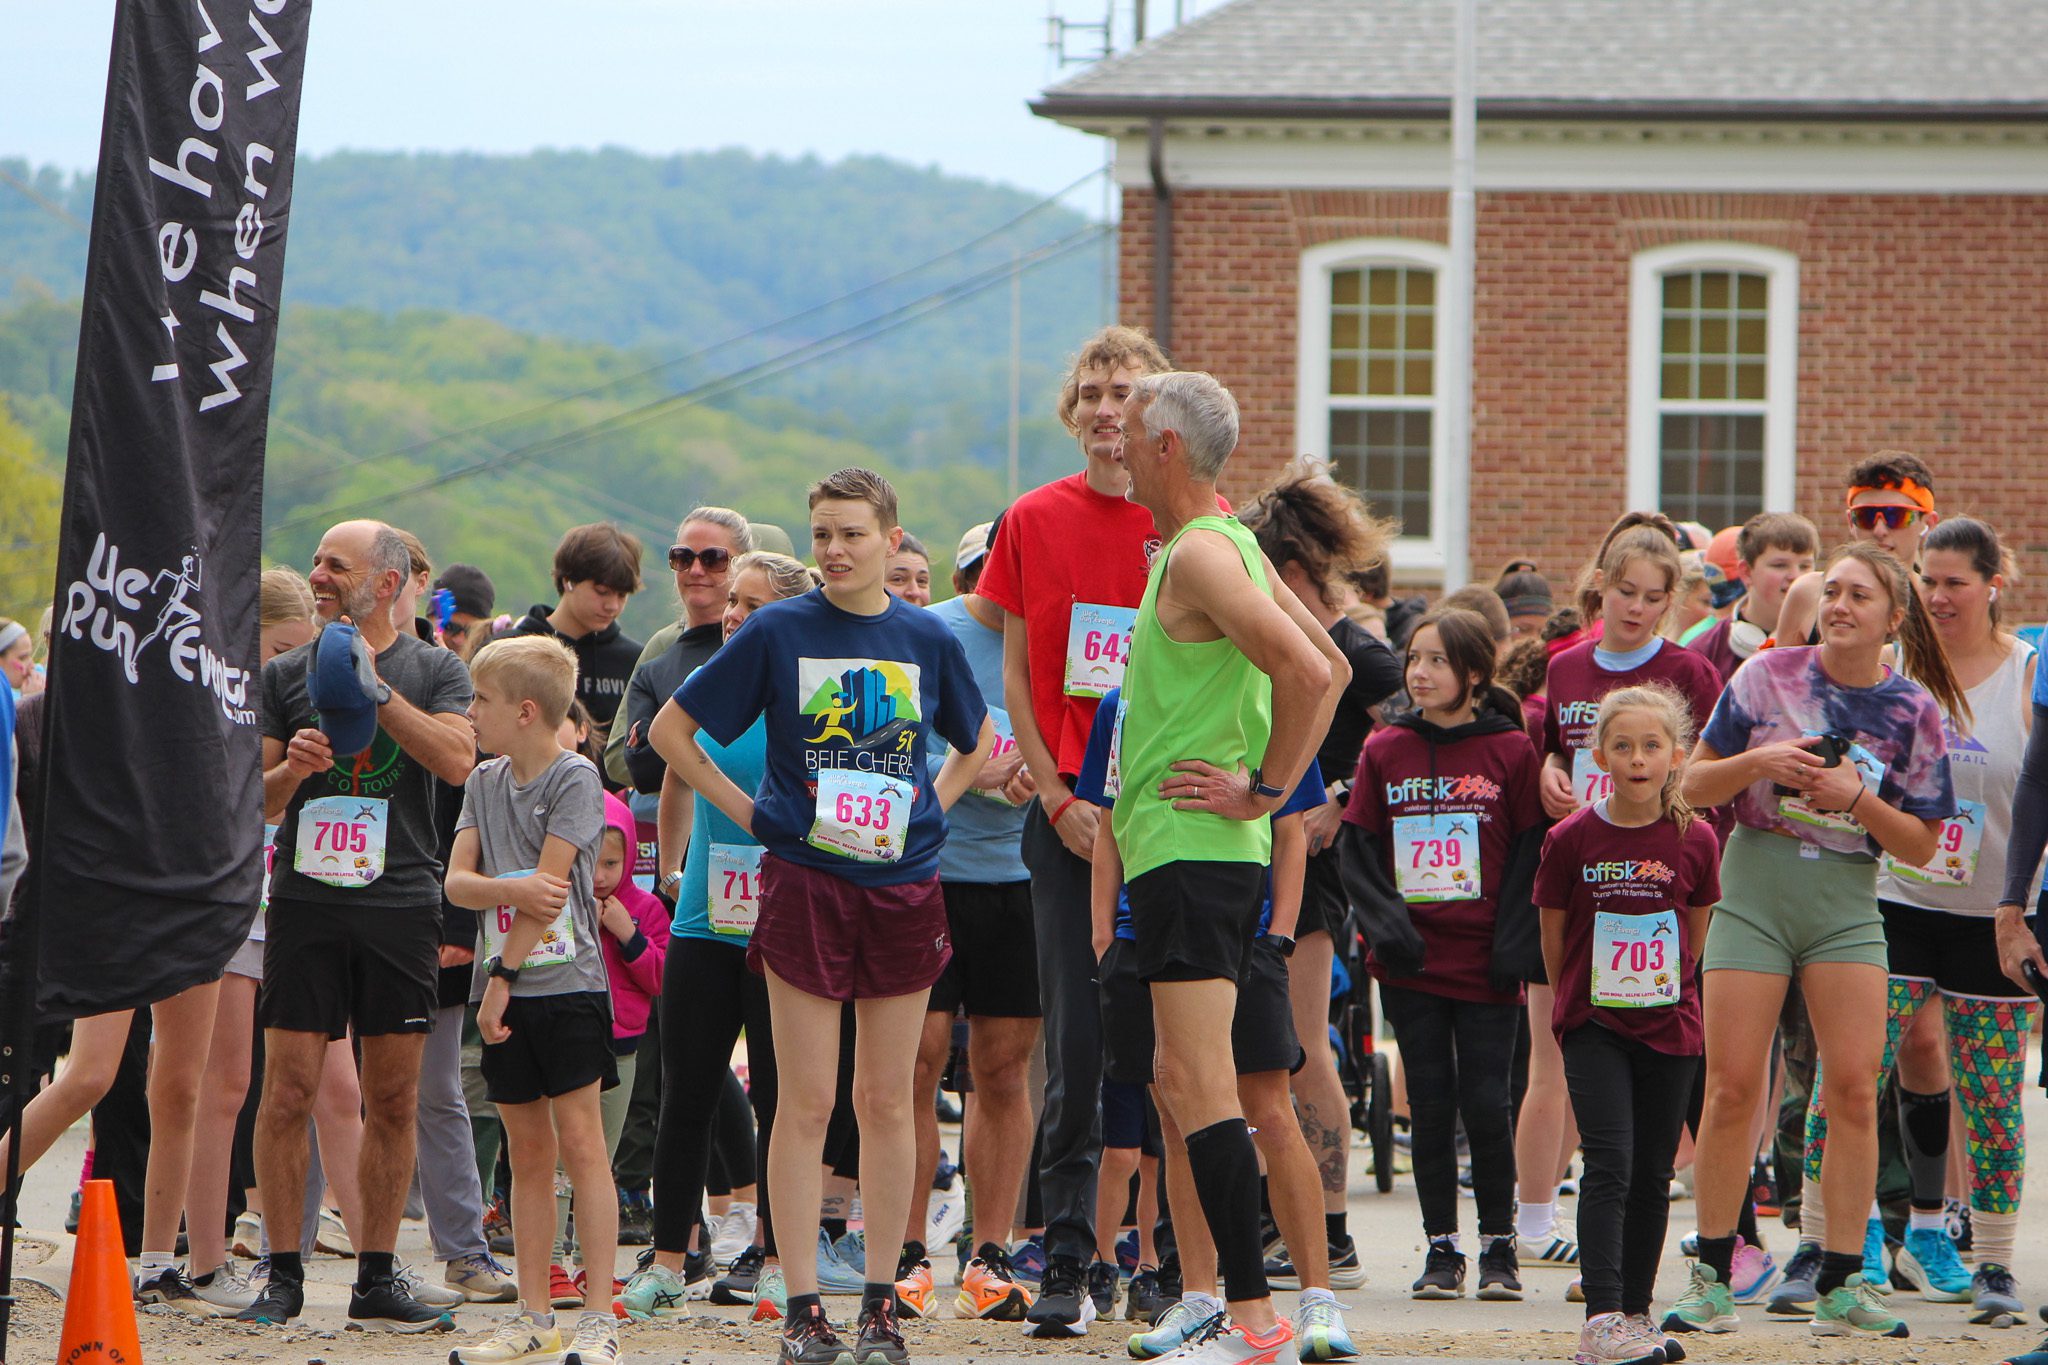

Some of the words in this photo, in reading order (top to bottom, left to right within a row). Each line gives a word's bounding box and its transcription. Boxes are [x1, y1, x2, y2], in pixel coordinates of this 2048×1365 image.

[1386, 776, 1455, 806] bff5k
[836, 792, 891, 831] 633
[1404, 804, 1439, 812] celebratig
[313, 821, 368, 853] 705
[1411, 838, 1462, 869] 739
[1583, 860, 1638, 883] bff5k
[1611, 939, 1665, 972] 703
